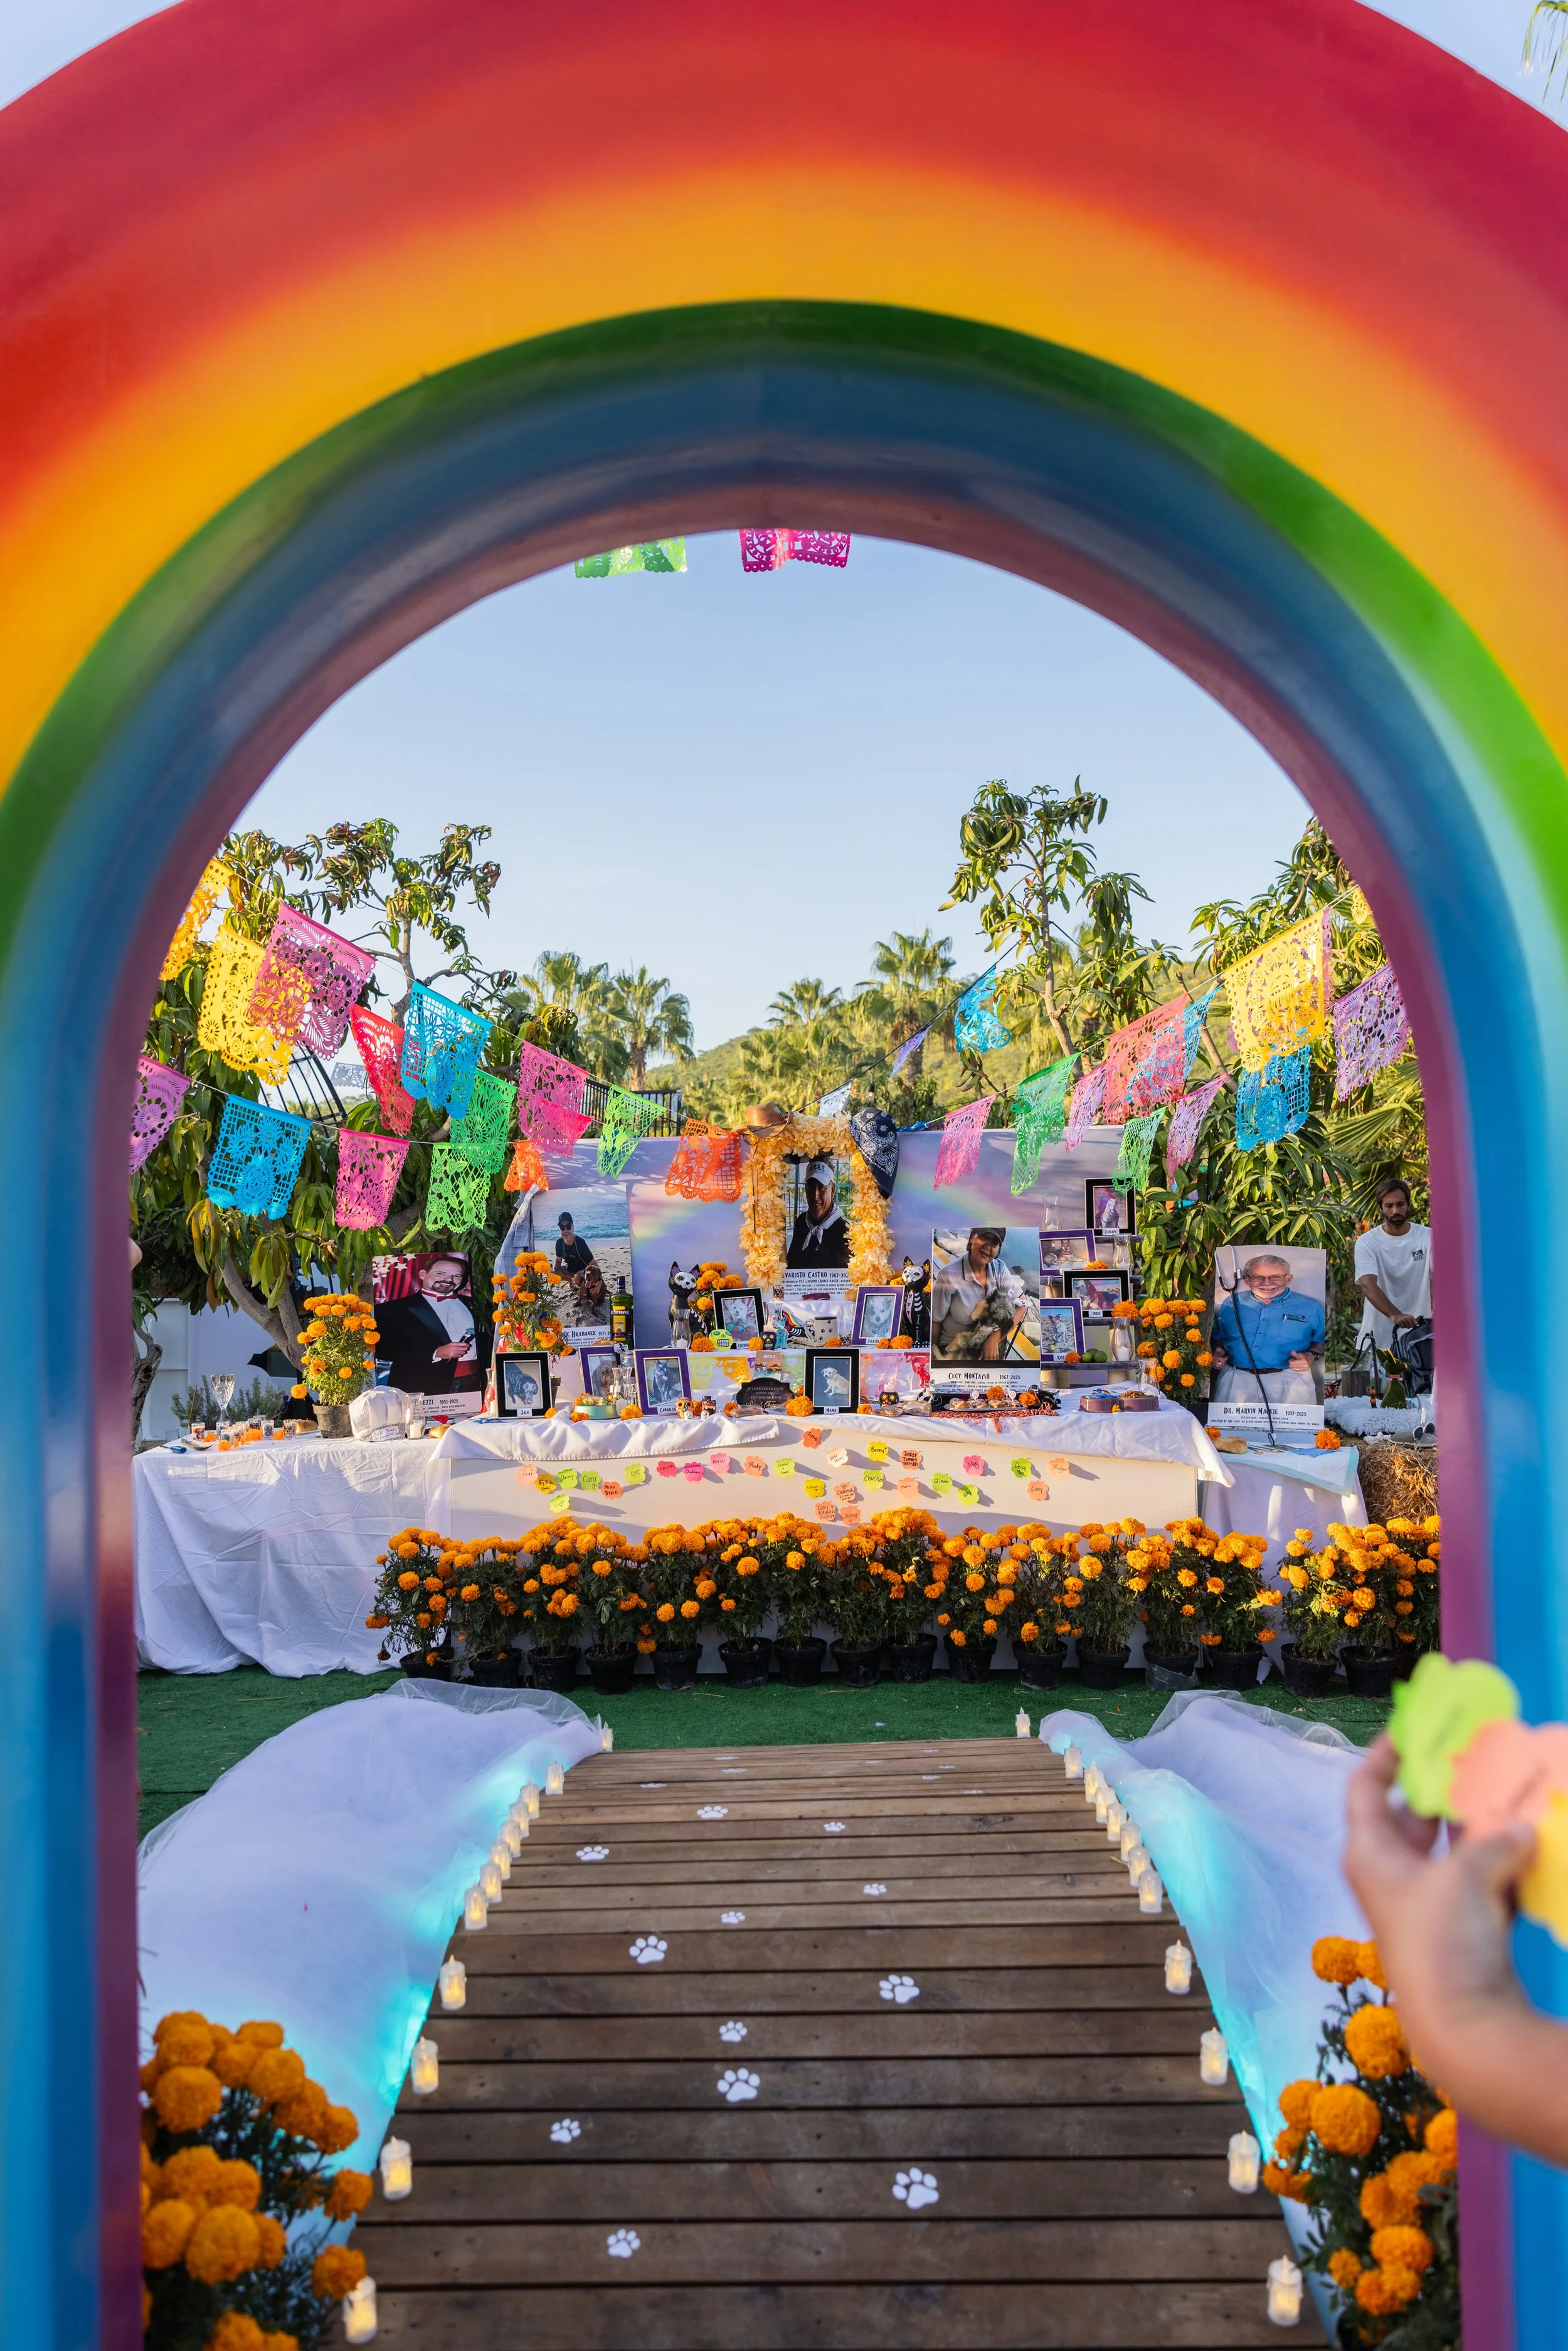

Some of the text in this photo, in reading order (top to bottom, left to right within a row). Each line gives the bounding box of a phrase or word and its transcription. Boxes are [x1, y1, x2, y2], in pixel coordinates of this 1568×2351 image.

[871, 1446, 884, 1454] Benny
[748, 1462, 762, 1471] Ruby
[967, 1461, 980, 1469] Meg
[1014, 1461, 1027, 1472] Daisy
